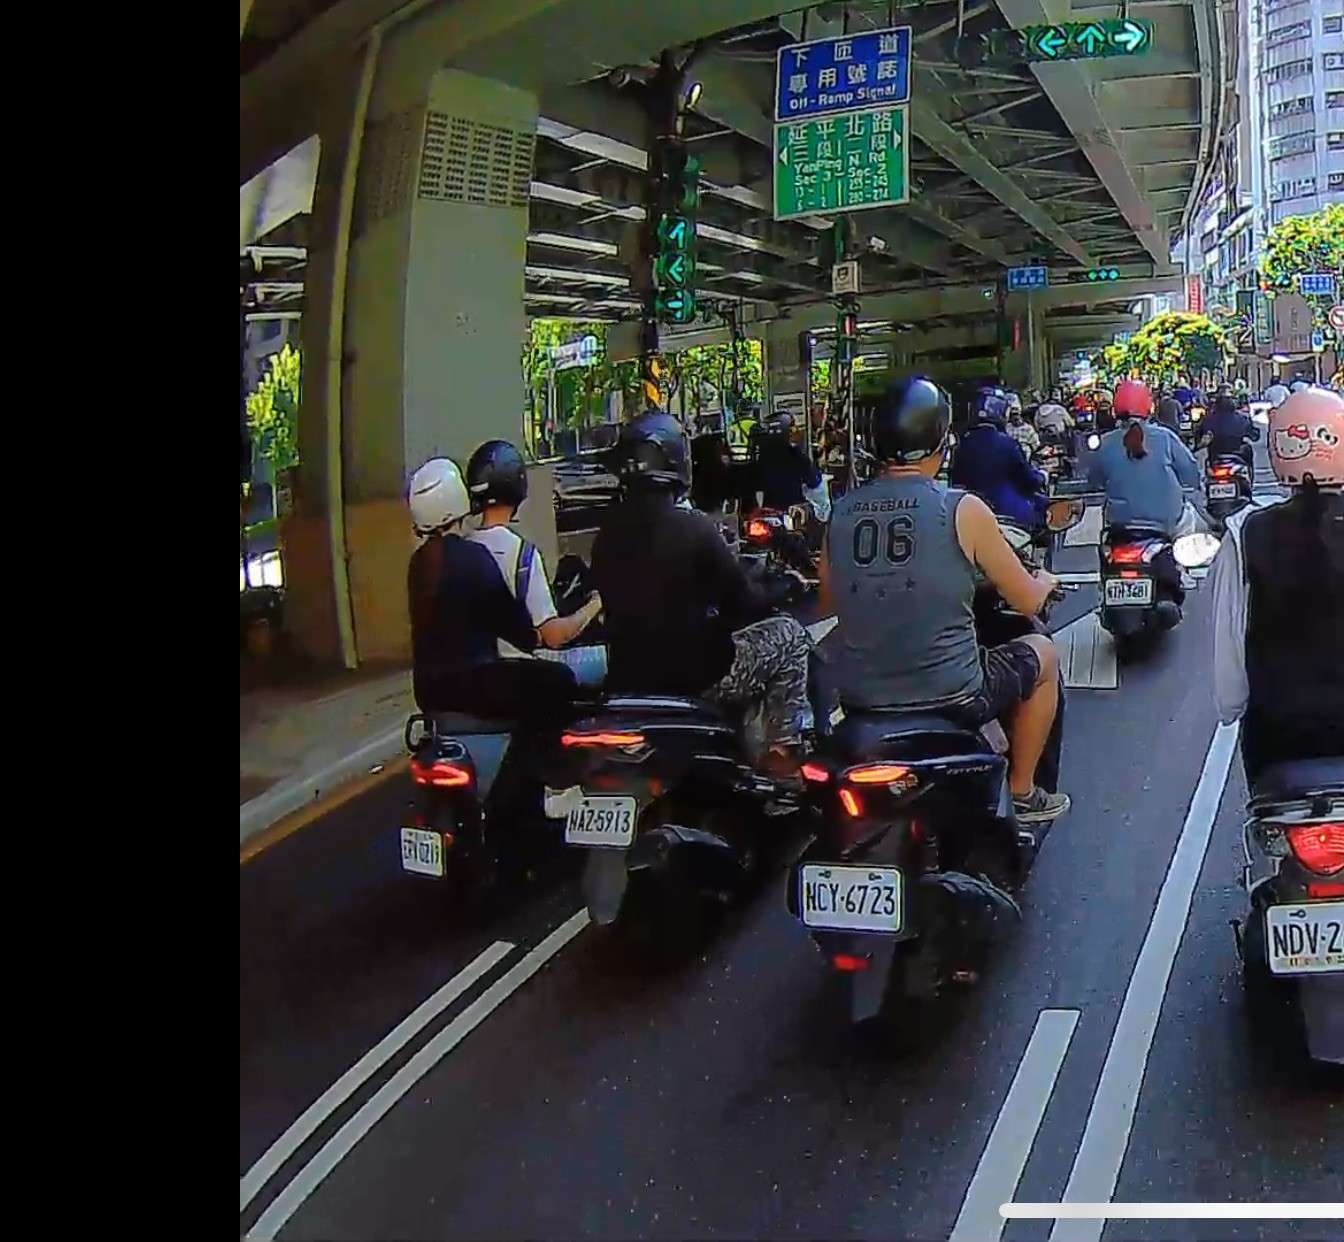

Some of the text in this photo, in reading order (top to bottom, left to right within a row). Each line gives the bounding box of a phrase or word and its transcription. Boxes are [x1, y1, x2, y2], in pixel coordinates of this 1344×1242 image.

[790, 34, 899, 68] 下匝道
[857, 84, 897, 100] Signal
[788, 112, 892, 145] 延平北路
[848, 154, 860, 167] N
[848, 167, 872, 178] Sec
[794, 175, 818, 186] Sec
[853, 498, 920, 512] BASEBALL
[853, 514, 915, 567] 06
